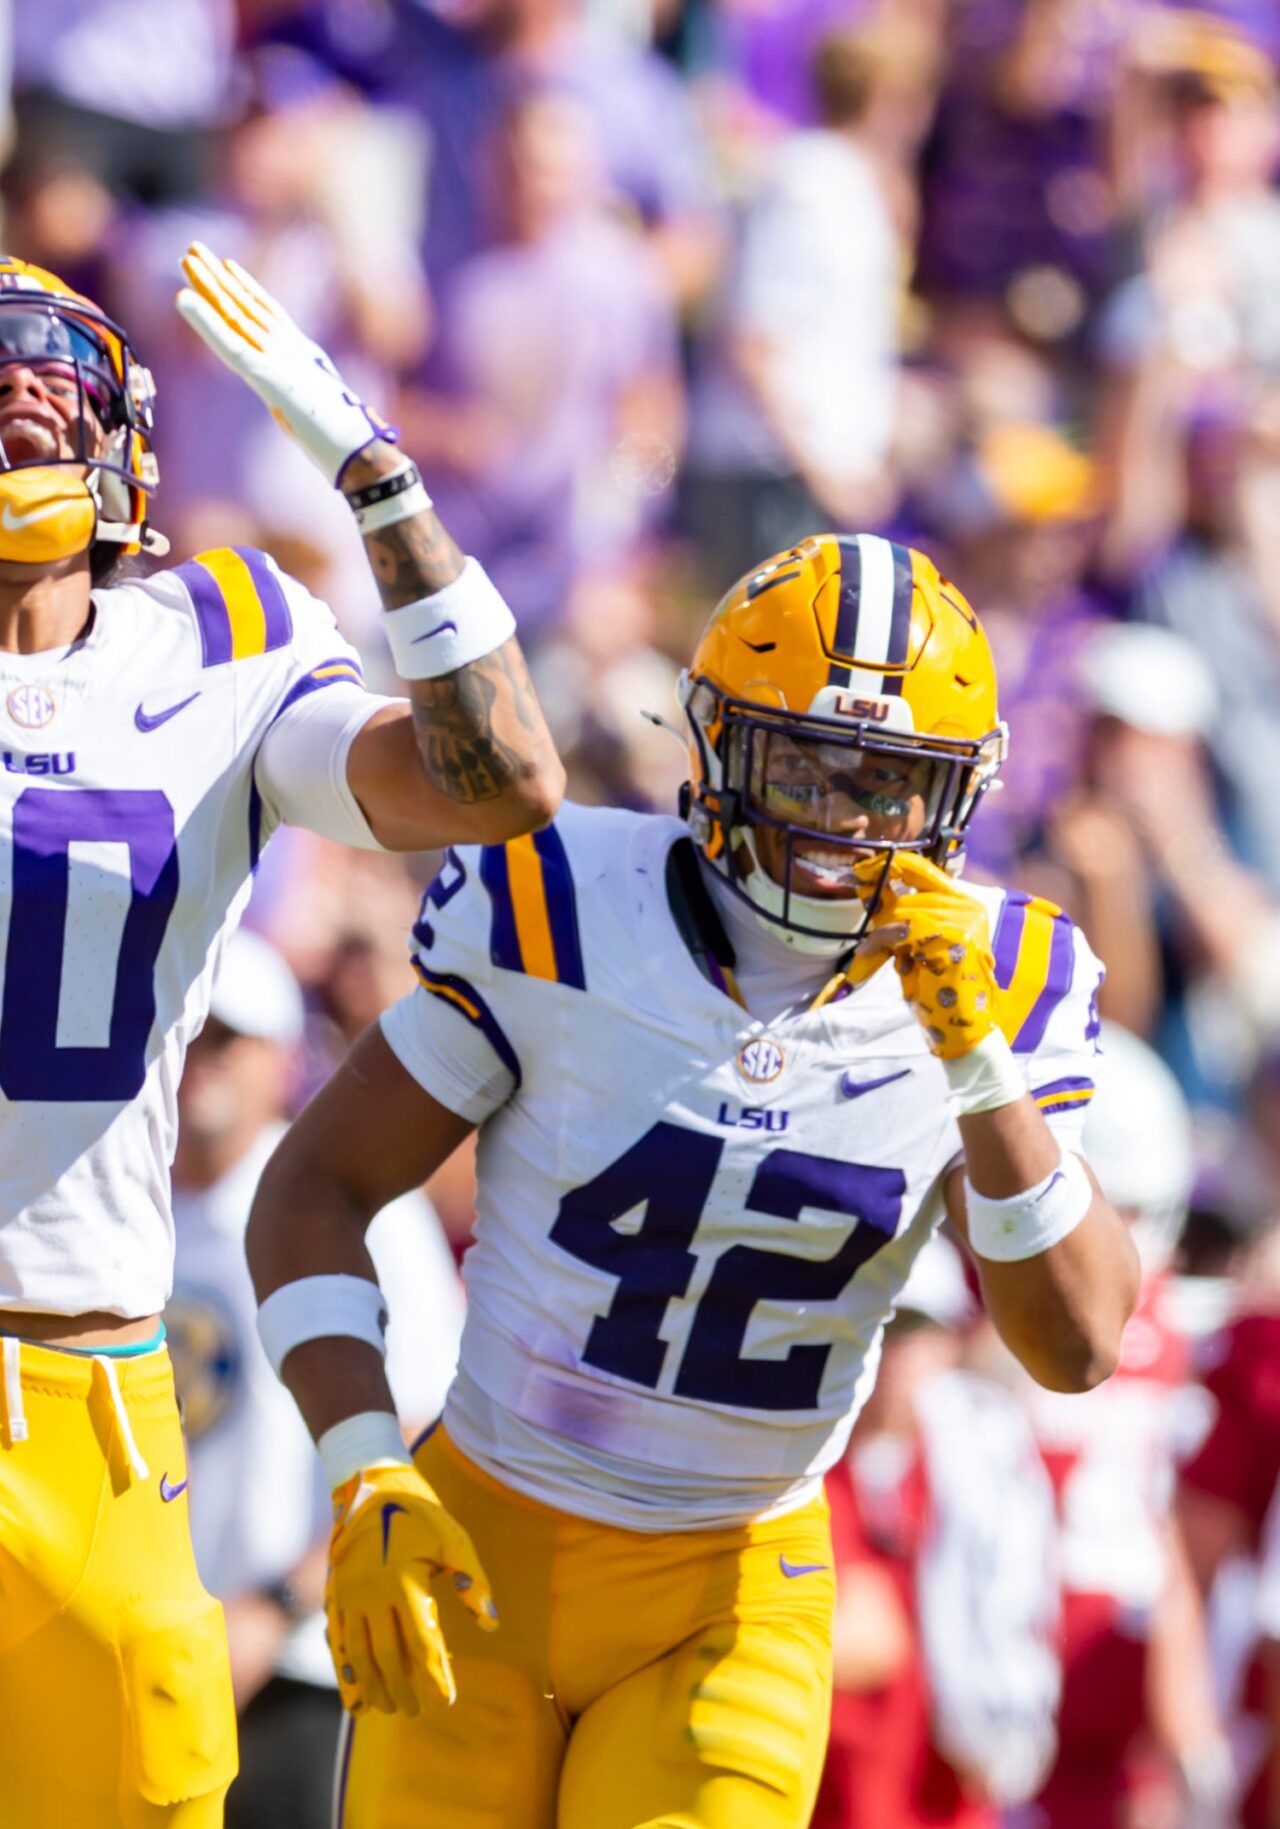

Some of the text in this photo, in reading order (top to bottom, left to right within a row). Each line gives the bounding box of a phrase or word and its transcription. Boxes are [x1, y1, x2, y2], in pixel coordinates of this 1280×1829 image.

[834, 694, 890, 722] LSU
[3, 751, 75, 775] LSU
[716, 1102, 789, 1132] LSU
[548, 1120, 907, 1411] 42
